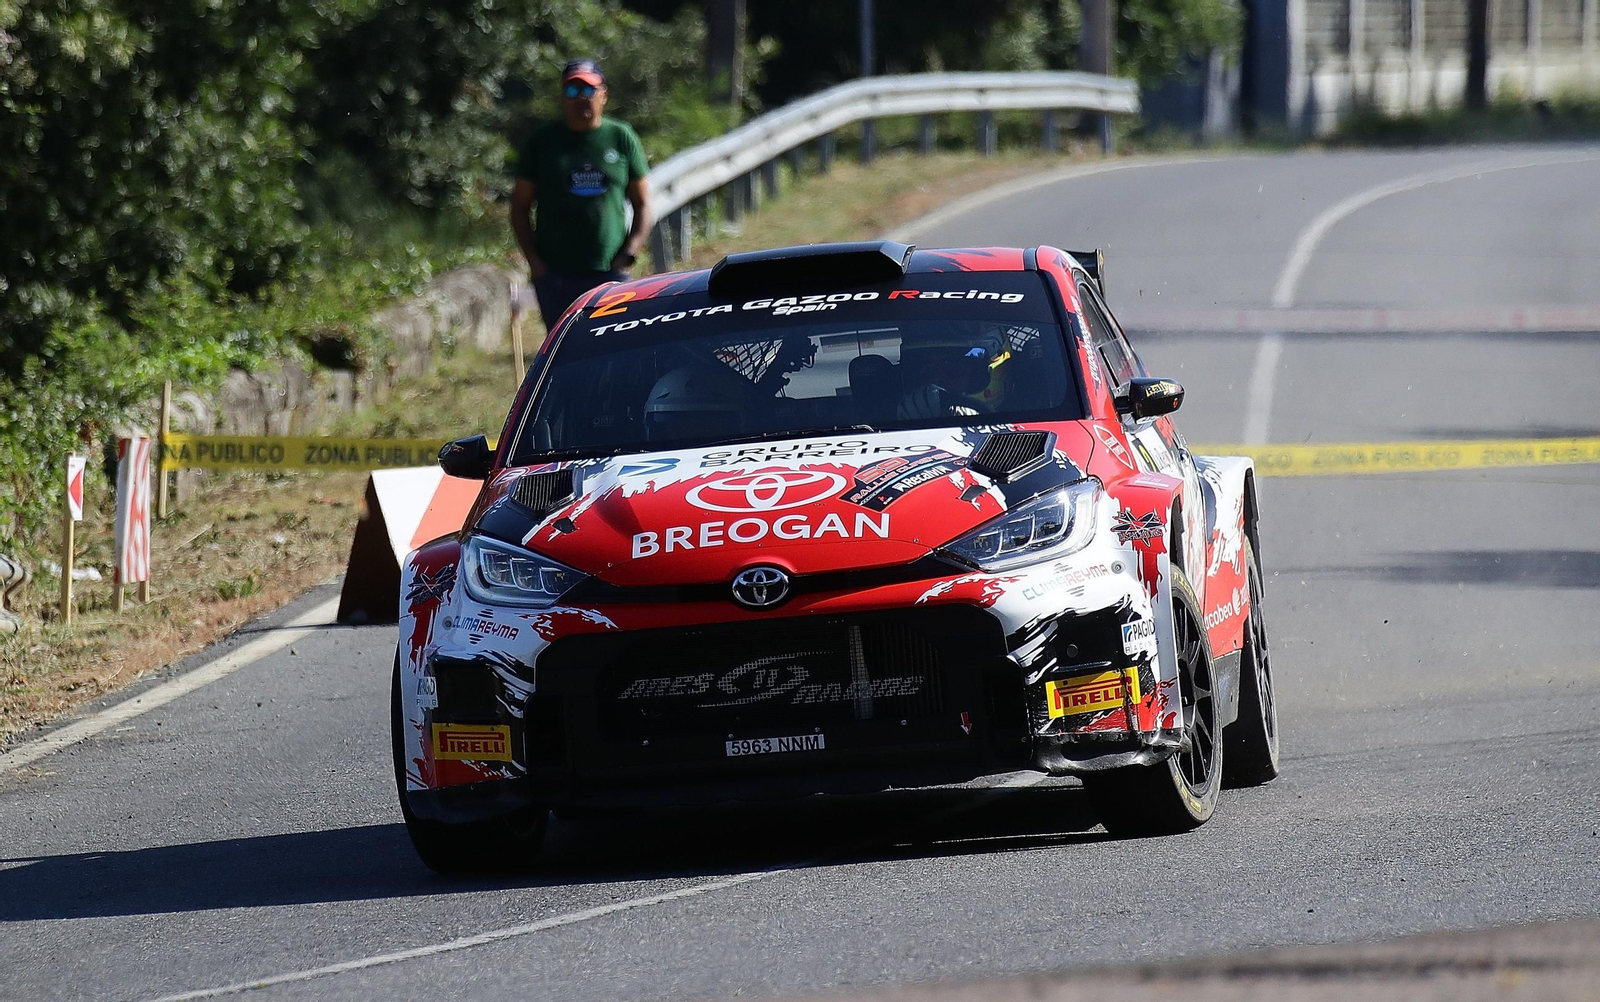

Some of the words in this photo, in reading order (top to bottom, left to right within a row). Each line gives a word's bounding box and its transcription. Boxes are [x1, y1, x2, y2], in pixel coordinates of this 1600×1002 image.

[589, 290, 637, 319] 2
[590, 304, 733, 337] TOYOTA
[888, 289, 1025, 304] Racing
[772, 302, 838, 316] Spain
[197, 441, 285, 464] PUBLICO
[305, 444, 361, 465] ZONA
[365, 444, 439, 466] PUBLIC
[699, 444, 937, 468] BARREIRO
[702, 440, 869, 460] GRUPO
[631, 513, 891, 559] BREOGAN
[1203, 601, 1233, 632] acobeo
[1132, 618, 1156, 641] PAGID
[1053, 676, 1134, 711] PIRELLI
[438, 731, 505, 754] PIRELLI
[731, 738, 773, 756] 5963
[777, 735, 820, 753] NNM
